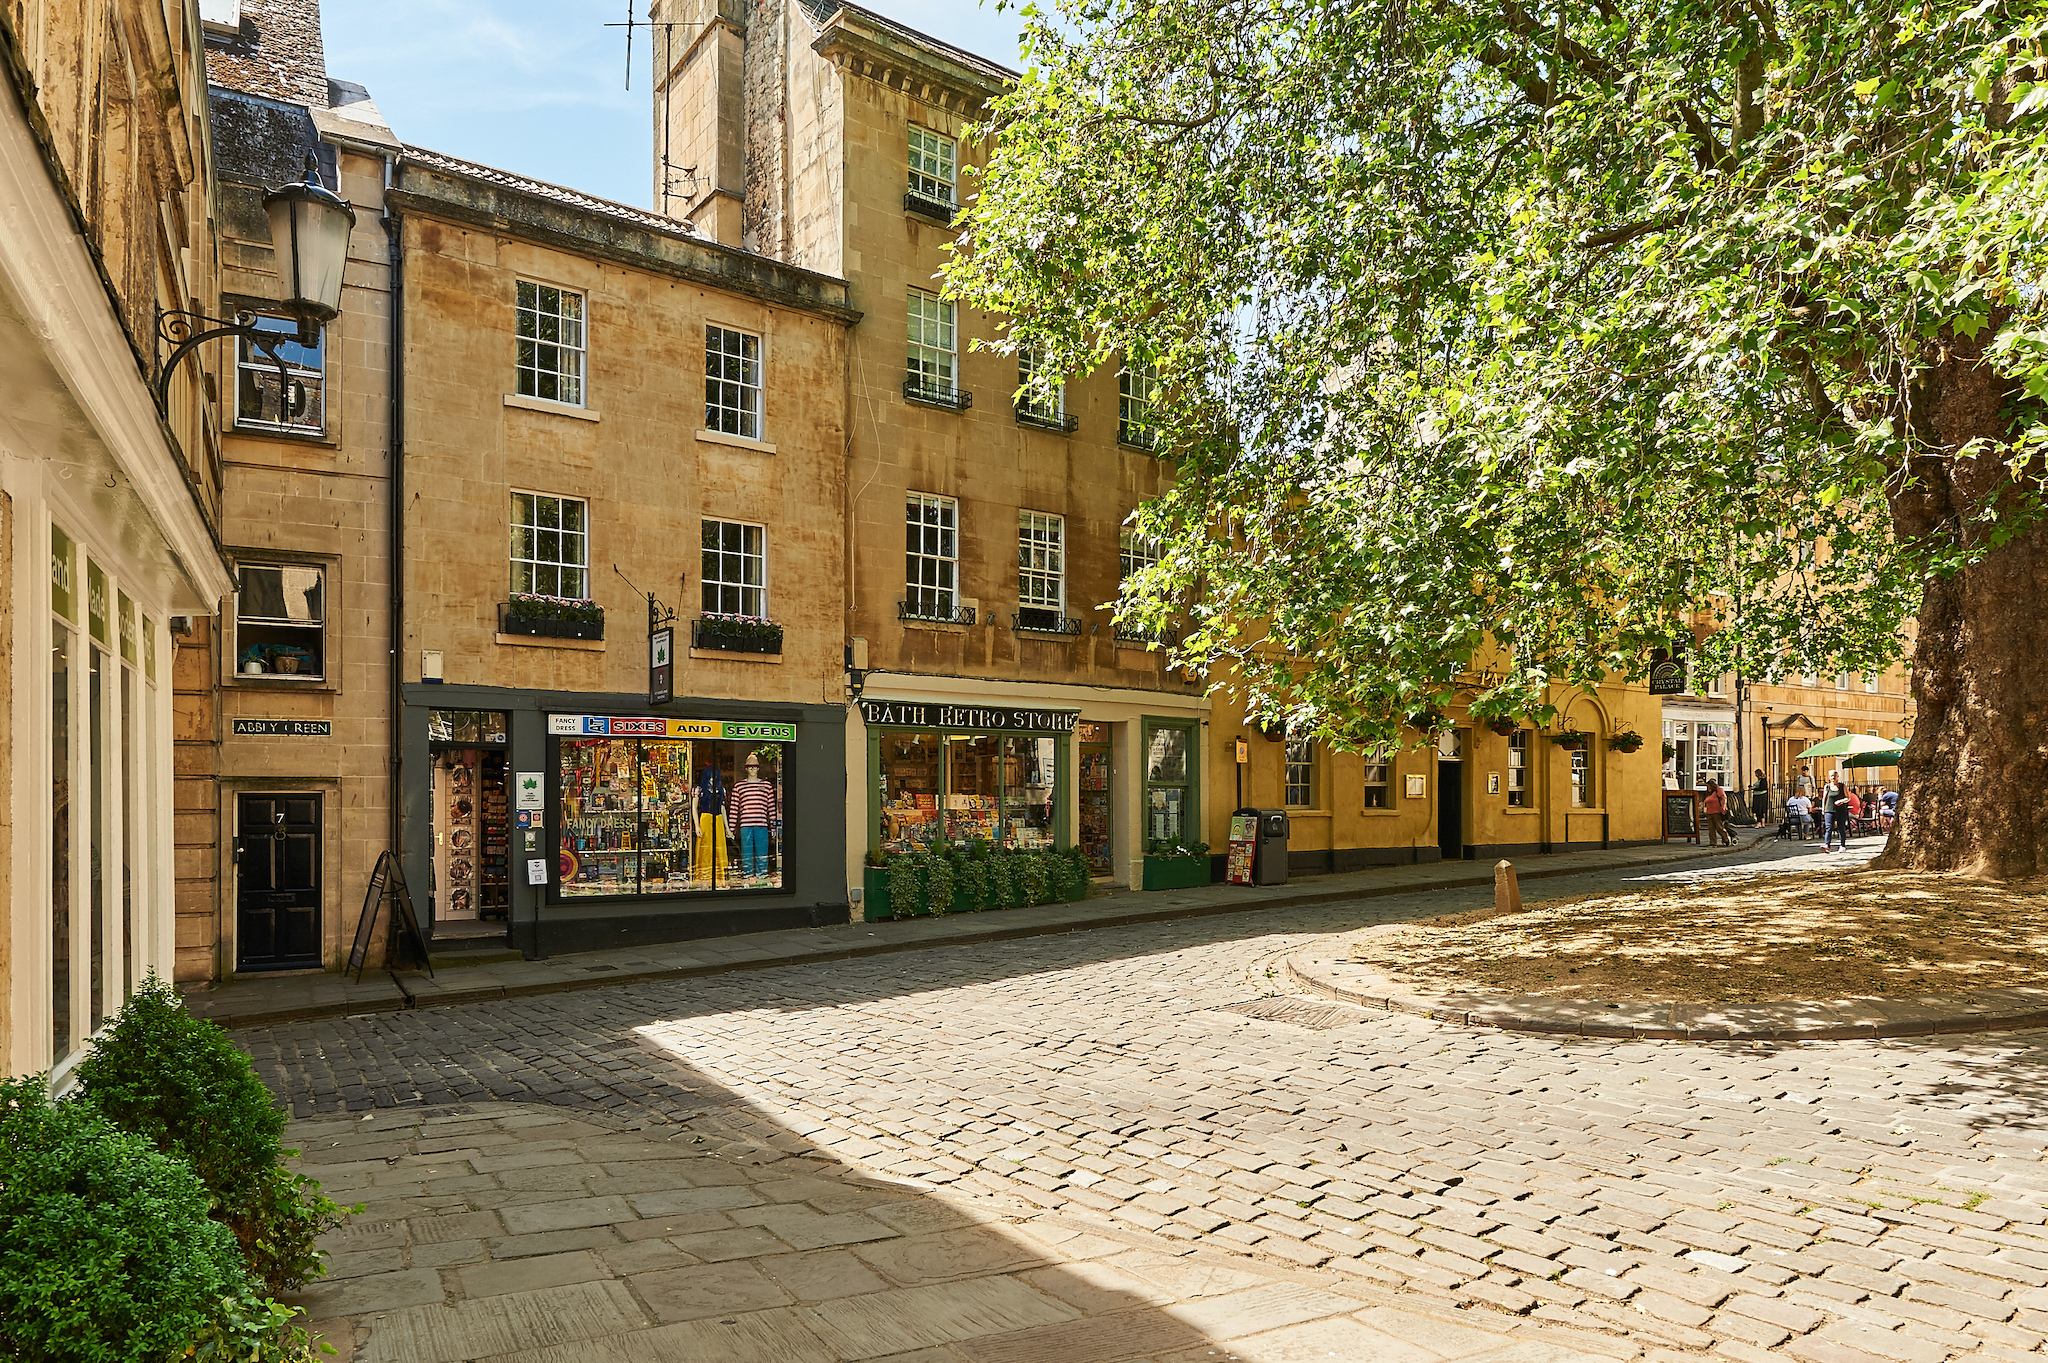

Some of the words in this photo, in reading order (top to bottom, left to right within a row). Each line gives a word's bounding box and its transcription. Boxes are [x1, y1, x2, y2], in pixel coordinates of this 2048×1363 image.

[867, 704, 926, 725] BATH
[939, 707, 1006, 727] RETRO
[1013, 711, 1075, 731] STORE
[588, 717, 605, 734] AT
[613, 721, 664, 732] SIXES
[676, 725, 712, 733] AND
[727, 726, 790, 737] SEVENS
[276, 813, 285, 824] 7
[567, 818, 598, 829] FANCY
[600, 818, 632, 829] DRESS
